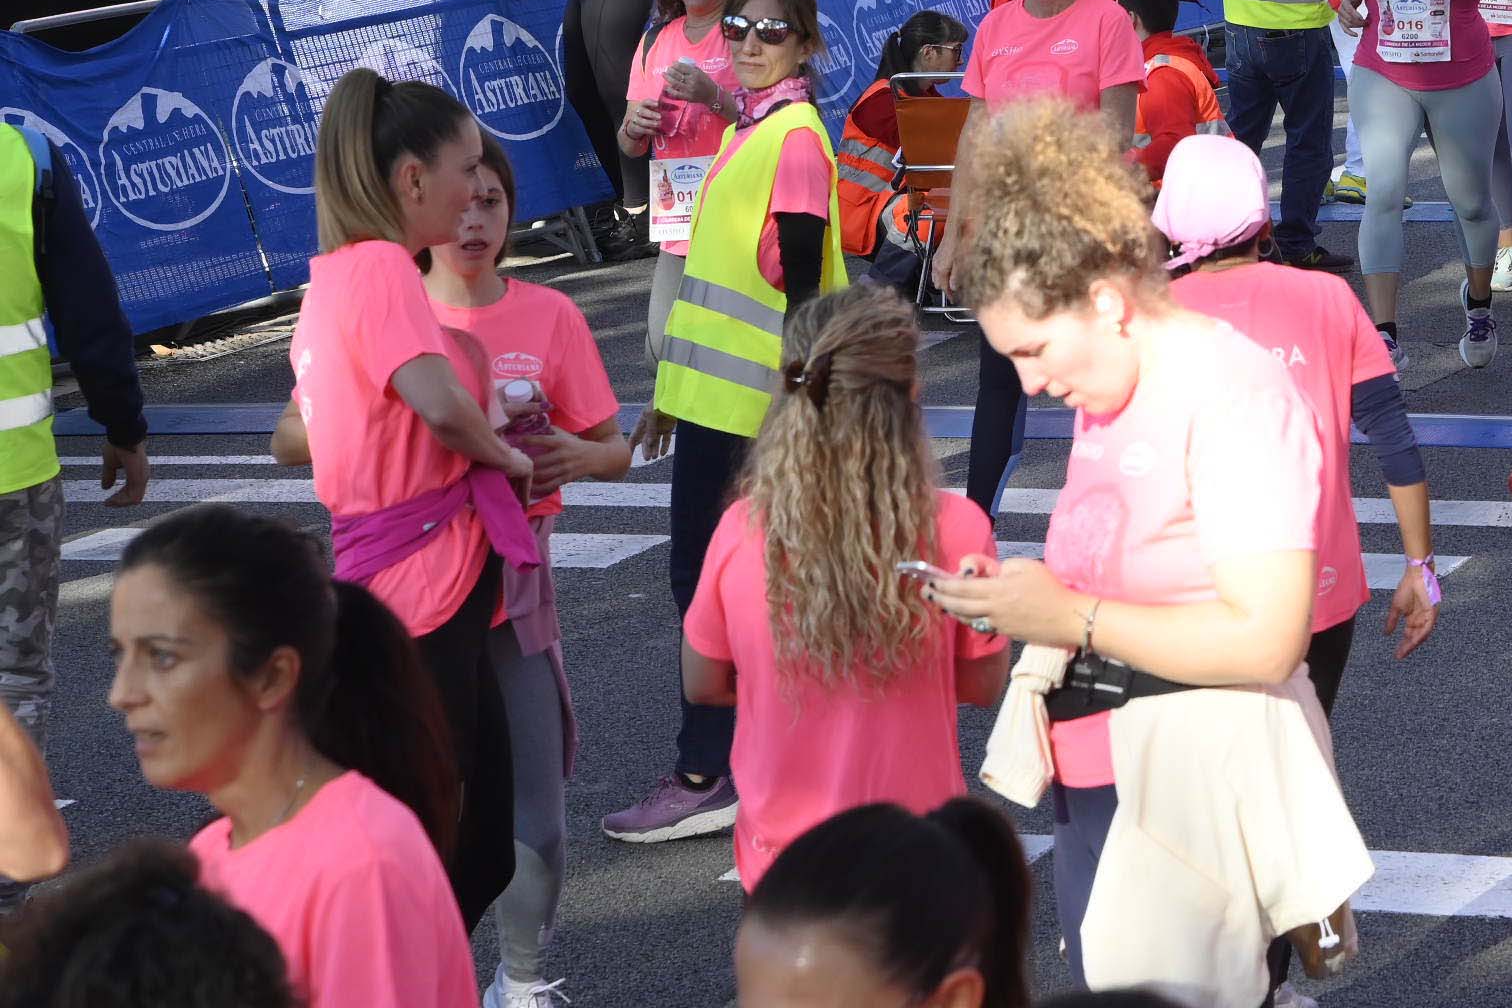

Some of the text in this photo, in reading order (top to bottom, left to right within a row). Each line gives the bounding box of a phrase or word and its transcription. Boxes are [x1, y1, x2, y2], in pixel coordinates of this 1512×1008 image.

[1397, 20, 1424, 30] 016
[469, 66, 561, 115] ASTURIANA
[112, 142, 225, 203] ASTURIANA
[676, 190, 699, 203] 01
